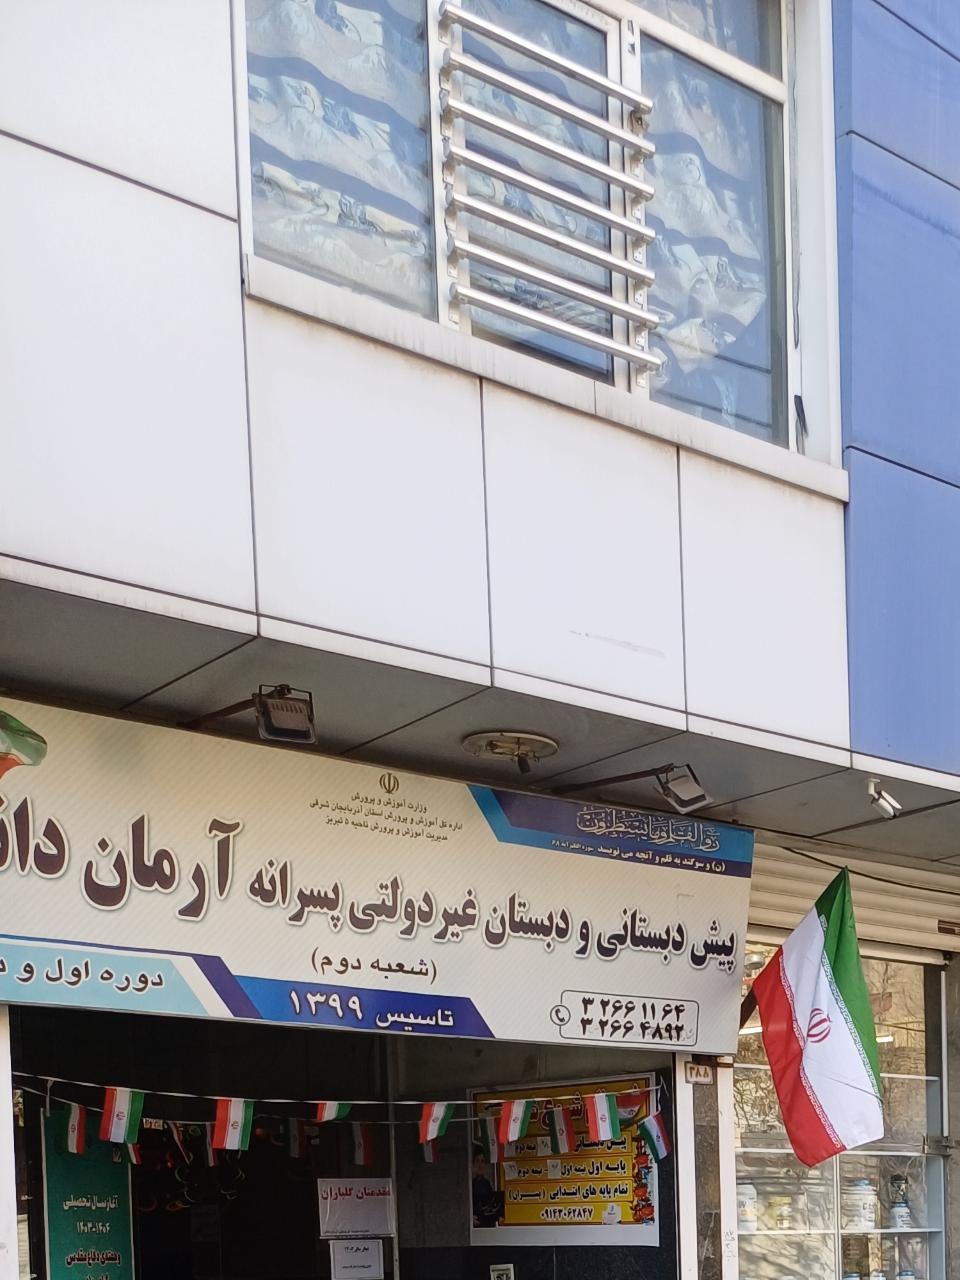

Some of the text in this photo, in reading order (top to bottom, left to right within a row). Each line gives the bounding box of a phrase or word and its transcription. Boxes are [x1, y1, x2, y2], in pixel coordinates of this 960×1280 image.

[309, 799, 330, 809] شرقی
[351, 792, 376, 806] پرورش
[383, 799, 406, 809] آموزش
[330, 802, 363, 814] آذربایجان
[363, 808, 384, 818] استان
[408, 801, 428, 813] وزارت
[325, 816, 343, 825] تبریز
[351, 820, 369, 830] ناحیه
[384, 813, 408, 824] پرورش
[415, 817, 438, 828] آموزش
[370, 823, 394, 835] پرورش
[401, 828, 424, 838] آموزش
[425, 831, 448, 842] مدیریت
[84, 816, 240, 917] آرمان
[250, 859, 340, 929] پسرانه
[485, 892, 570, 949] دبستان
[575, 919, 590, 956] و
[597, 907, 685, 962] دبستانی
[690, 920, 735, 972] پیش
[15, 961, 35, 983] و
[45, 958, 90, 985] اول
[99, 968, 164, 992] دوره
[289, 989, 454, 1031] تاسیس ۱۳۹۹
[588, 1160, 603, 1175] اول
[613, 1183, 629, 1197] تمام
